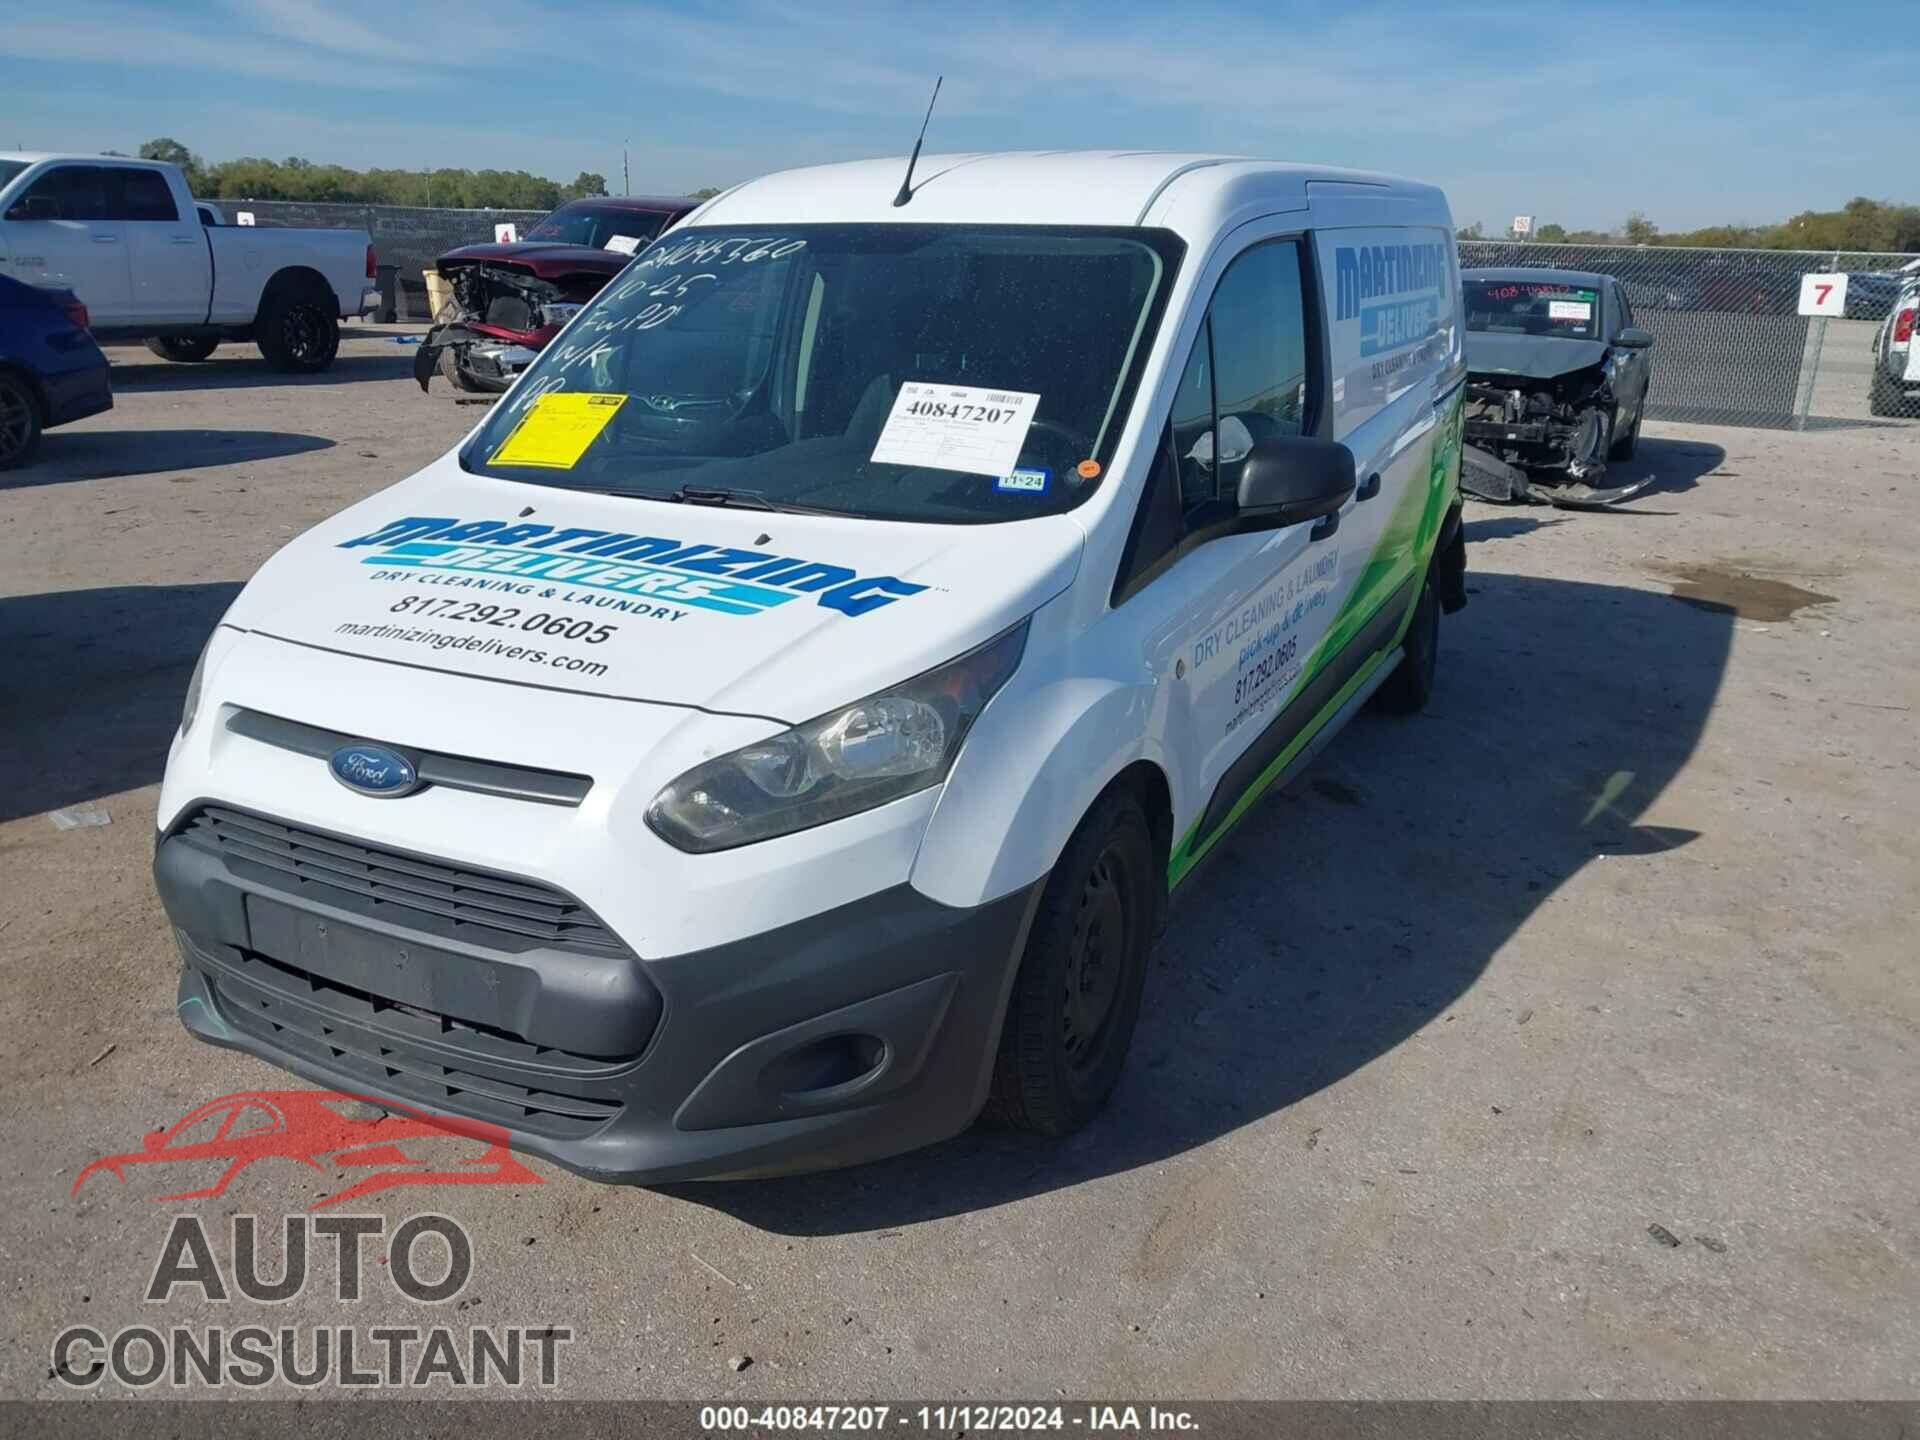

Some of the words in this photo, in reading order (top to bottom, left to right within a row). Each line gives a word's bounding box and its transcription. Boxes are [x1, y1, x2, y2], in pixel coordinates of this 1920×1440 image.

[1815, 285, 1833, 305] 7
[906, 400, 1016, 425] 40847207
[336, 517, 931, 617] MARTINIZING
[421, 549, 738, 600] DELIVERS
[369, 570, 418, 581] DRY
[417, 571, 535, 596] CLEANING
[538, 587, 557, 598] &
[563, 590, 688, 622] LAUNDRY
[390, 595, 618, 644] 817.292.0605
[335, 622, 608, 677] martinizingdelivers.com
[1194, 629, 1223, 669] DRY
[1225, 587, 1285, 646] CLEANING
[342, 752, 389, 785] Ford
